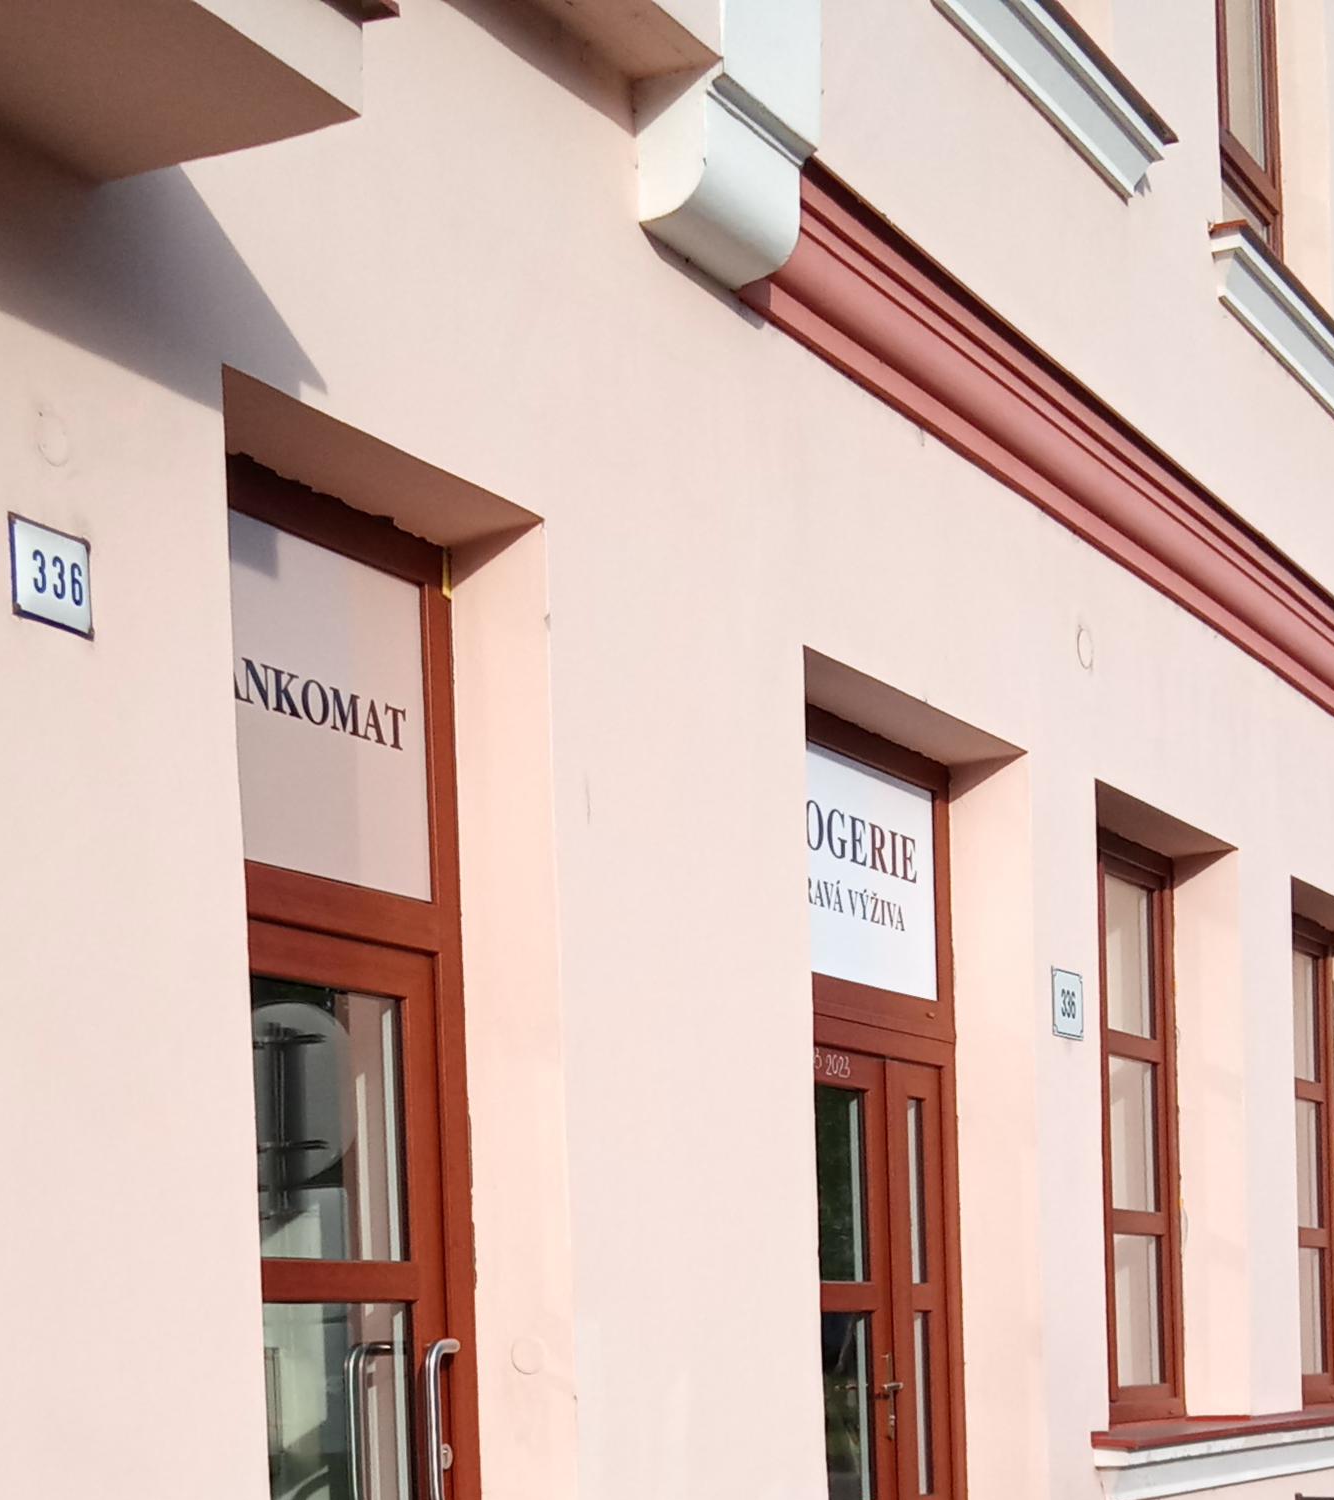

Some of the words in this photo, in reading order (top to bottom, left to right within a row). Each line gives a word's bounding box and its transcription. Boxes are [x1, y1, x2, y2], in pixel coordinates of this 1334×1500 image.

[31, 548, 84, 607] 336
[806, 799, 918, 884] OGERIE
[847, 888, 906, 931] VÝŽIVA
[1061, 987, 1077, 1019] 336
[825, 1053, 851, 1078] 2023
